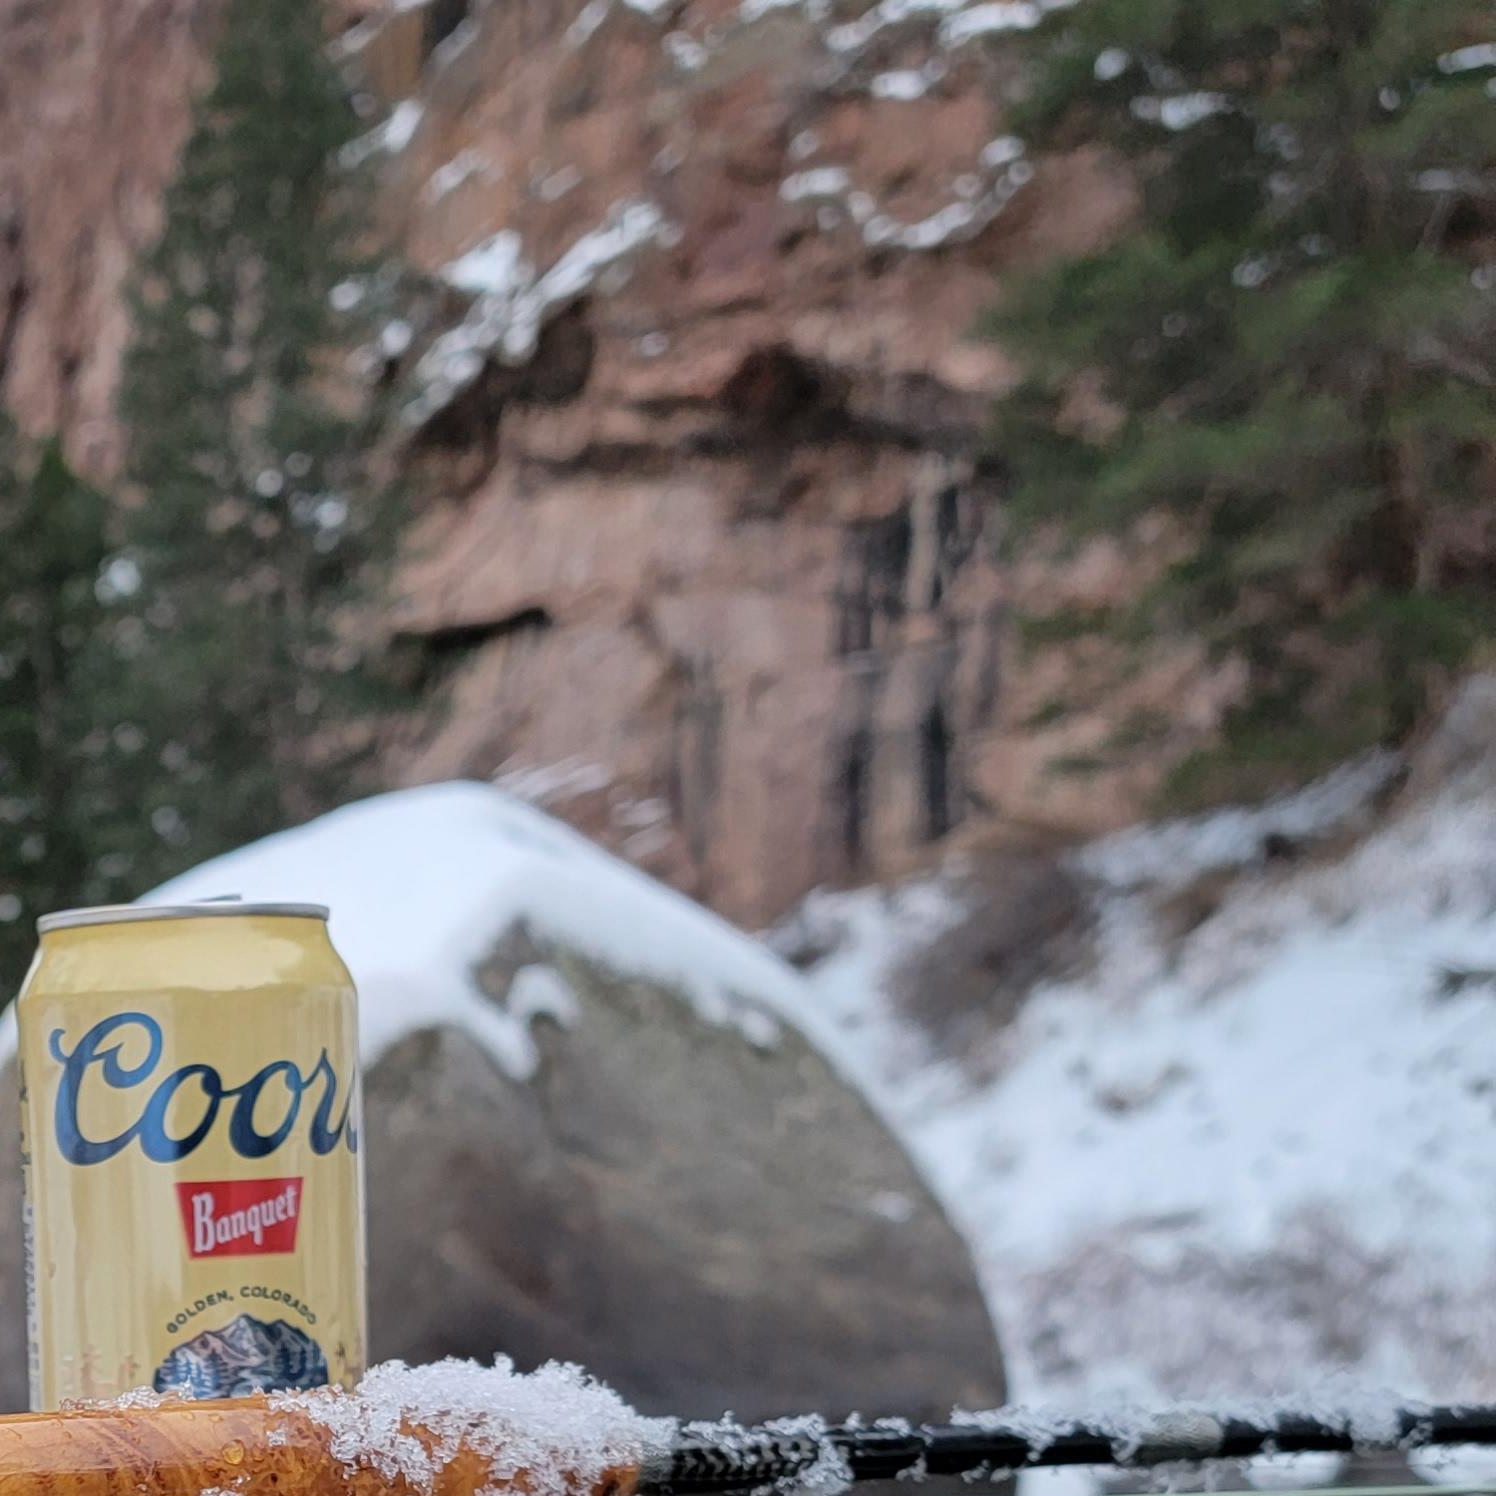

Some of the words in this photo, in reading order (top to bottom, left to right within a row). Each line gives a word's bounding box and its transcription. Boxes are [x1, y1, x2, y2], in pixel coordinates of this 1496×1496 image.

[191, 1185, 298, 1255] Banquet
[166, 1289, 235, 1334] GOLDEN,
[239, 1285, 318, 1326] COLORADO
